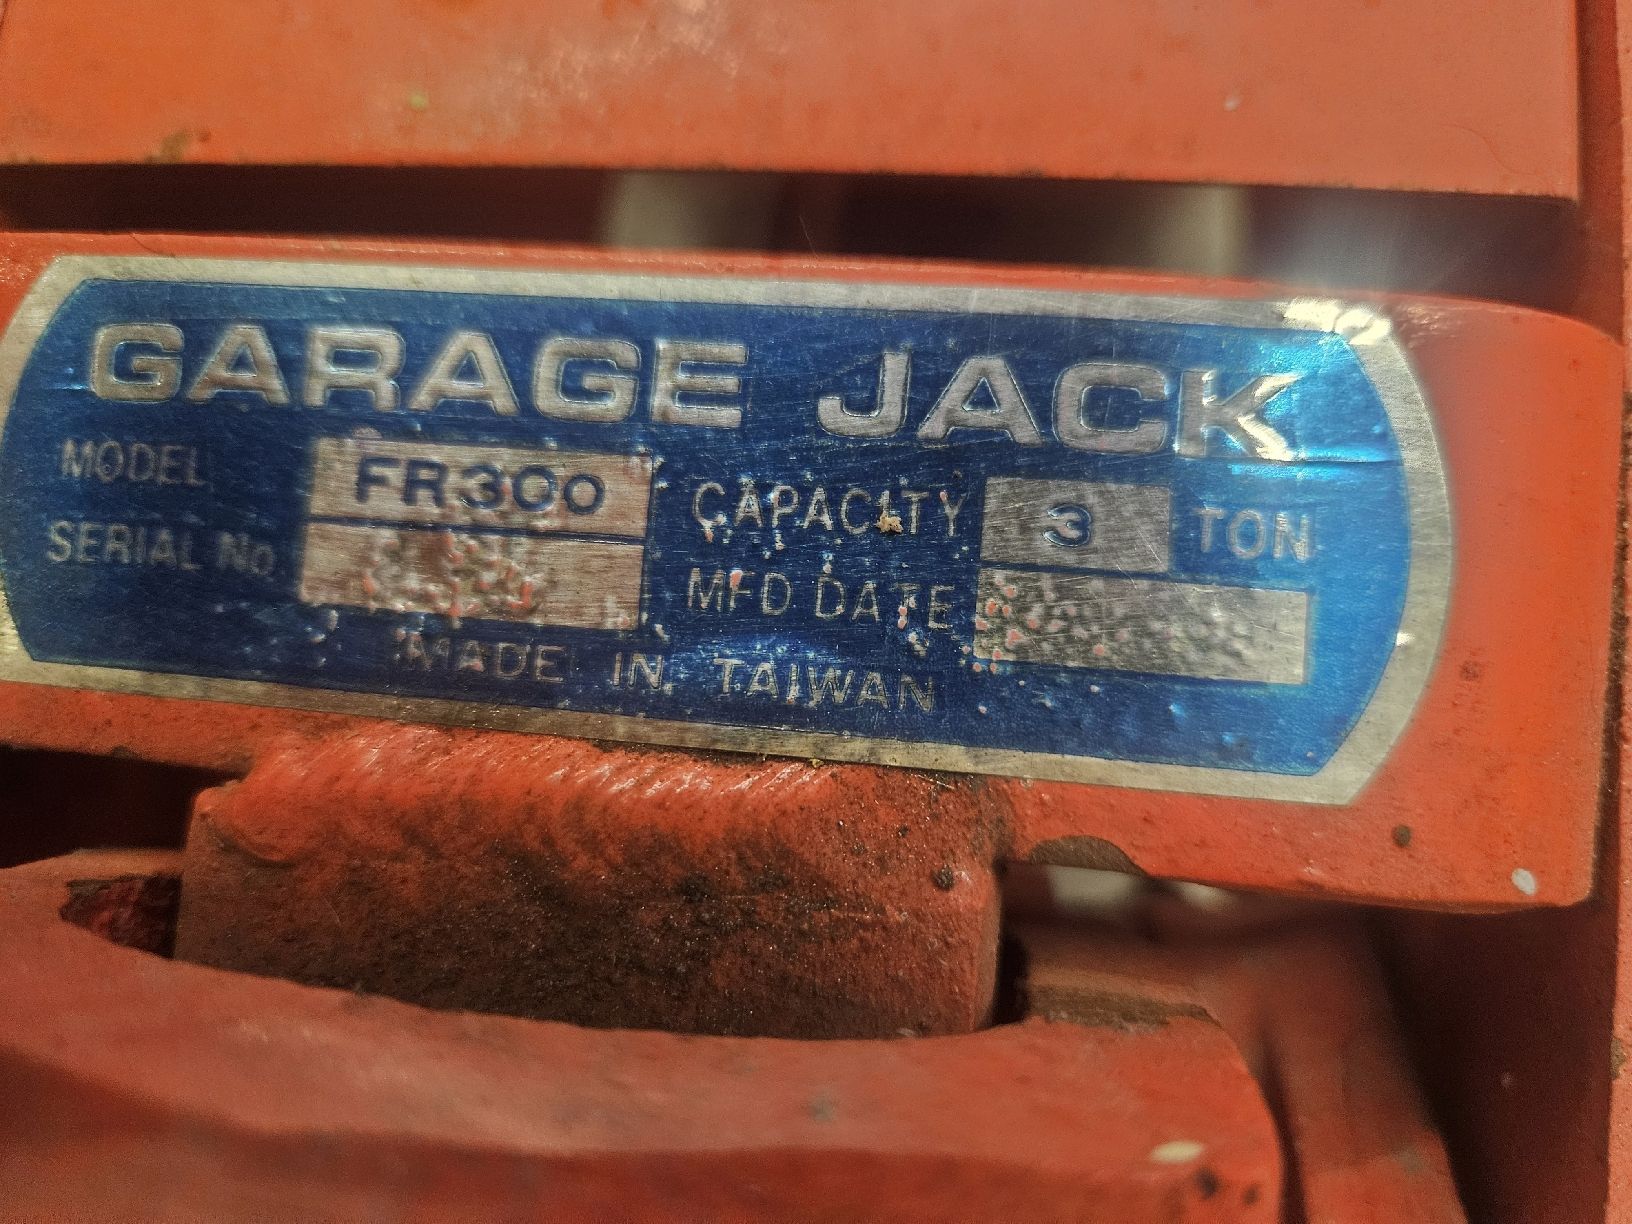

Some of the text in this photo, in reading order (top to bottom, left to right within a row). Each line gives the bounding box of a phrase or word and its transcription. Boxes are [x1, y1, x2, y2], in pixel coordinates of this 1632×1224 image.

[88, 321, 1300, 463] GARAGE JACK
[60, 440, 606, 515] MODEL FR300
[46, 519, 199, 572] SERIAL
[692, 482, 1314, 563] CAPACITY 3 TON
[687, 567, 955, 631] MFD DATE
[399, 632, 937, 713] MADE IN TAIWAN
